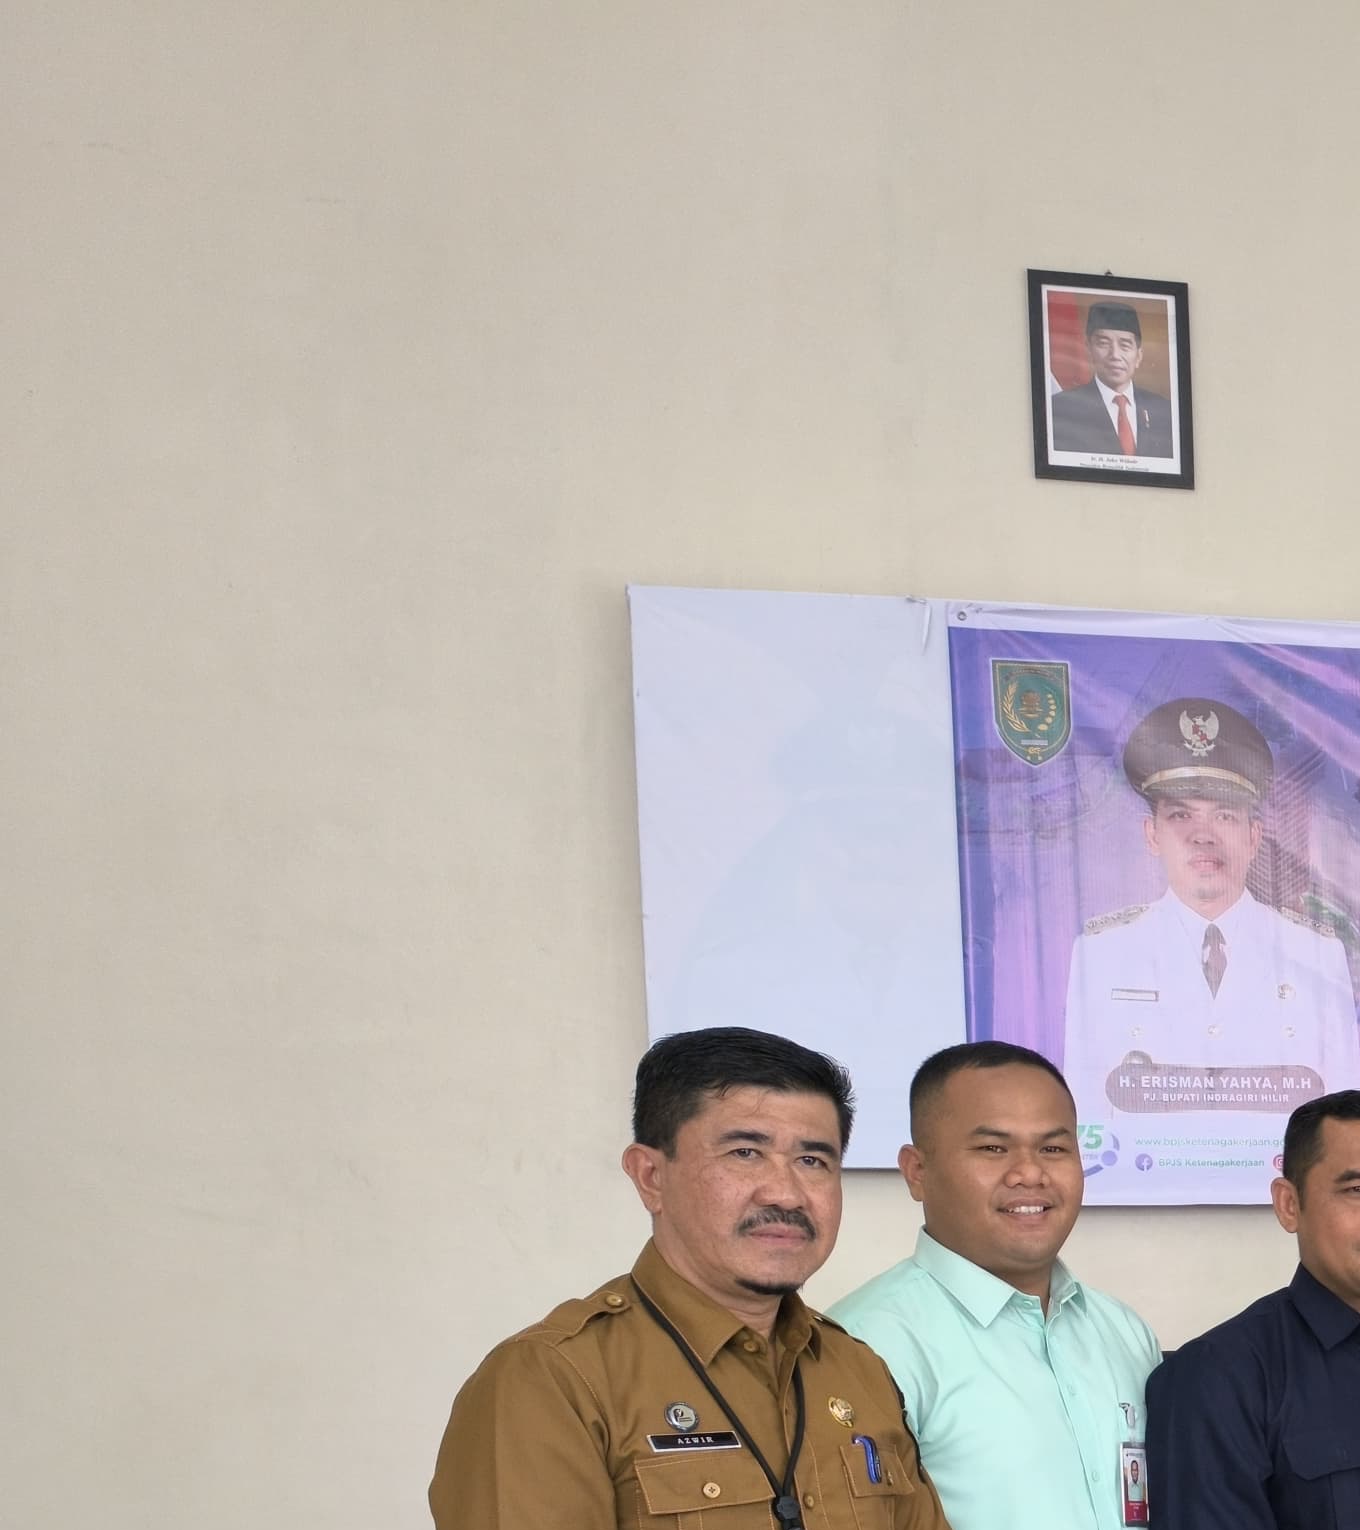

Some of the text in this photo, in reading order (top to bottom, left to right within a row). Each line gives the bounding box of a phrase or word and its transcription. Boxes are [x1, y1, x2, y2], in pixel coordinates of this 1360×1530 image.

[1119, 1075, 1312, 1091] H. ERISMAN YAHYA, M.H
[1162, 1093, 1200, 1102] BUPATI
[1203, 1093, 1258, 1102] INDRAGIRI
[1261, 1093, 1290, 1102] HILIR
[1158, 1158, 1265, 1169] BPJS Ketenagakerjaan
[677, 1436, 715, 1445] AZWIR
